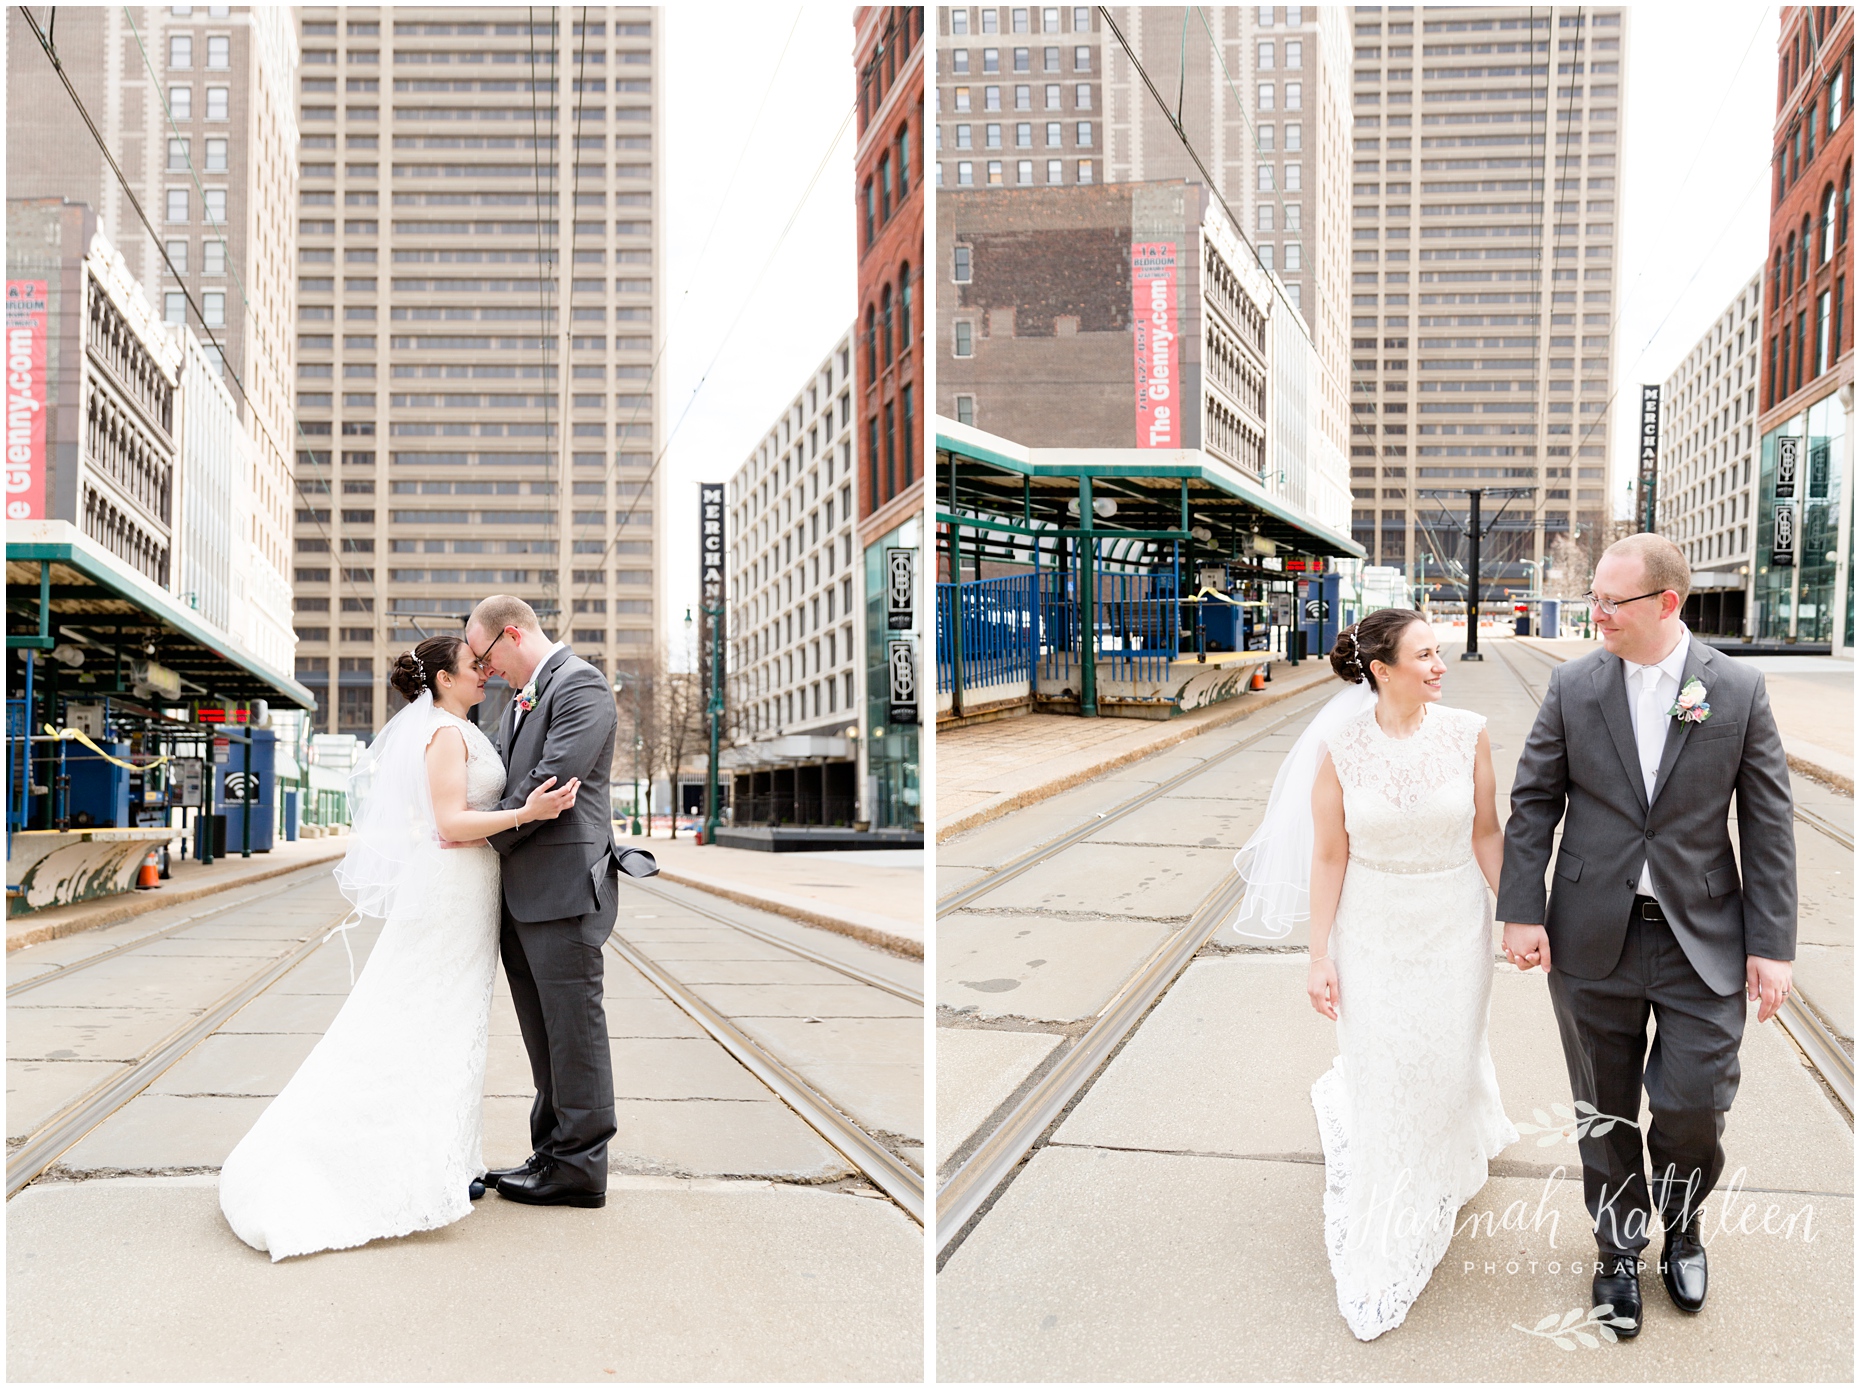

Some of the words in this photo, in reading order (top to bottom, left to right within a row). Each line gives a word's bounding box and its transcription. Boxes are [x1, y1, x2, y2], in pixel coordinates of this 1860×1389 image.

[1134, 258, 1175, 266] BEDROOM
[1141, 246, 1146, 256] 1
[1149, 247, 1156, 256] &
[1160, 245, 1167, 256] 2
[25, 284, 35, 297] 2
[1148, 279, 1174, 401] Glenny.com
[6, 329, 40, 494] Glenny.com
[1149, 405, 1171, 447] The
